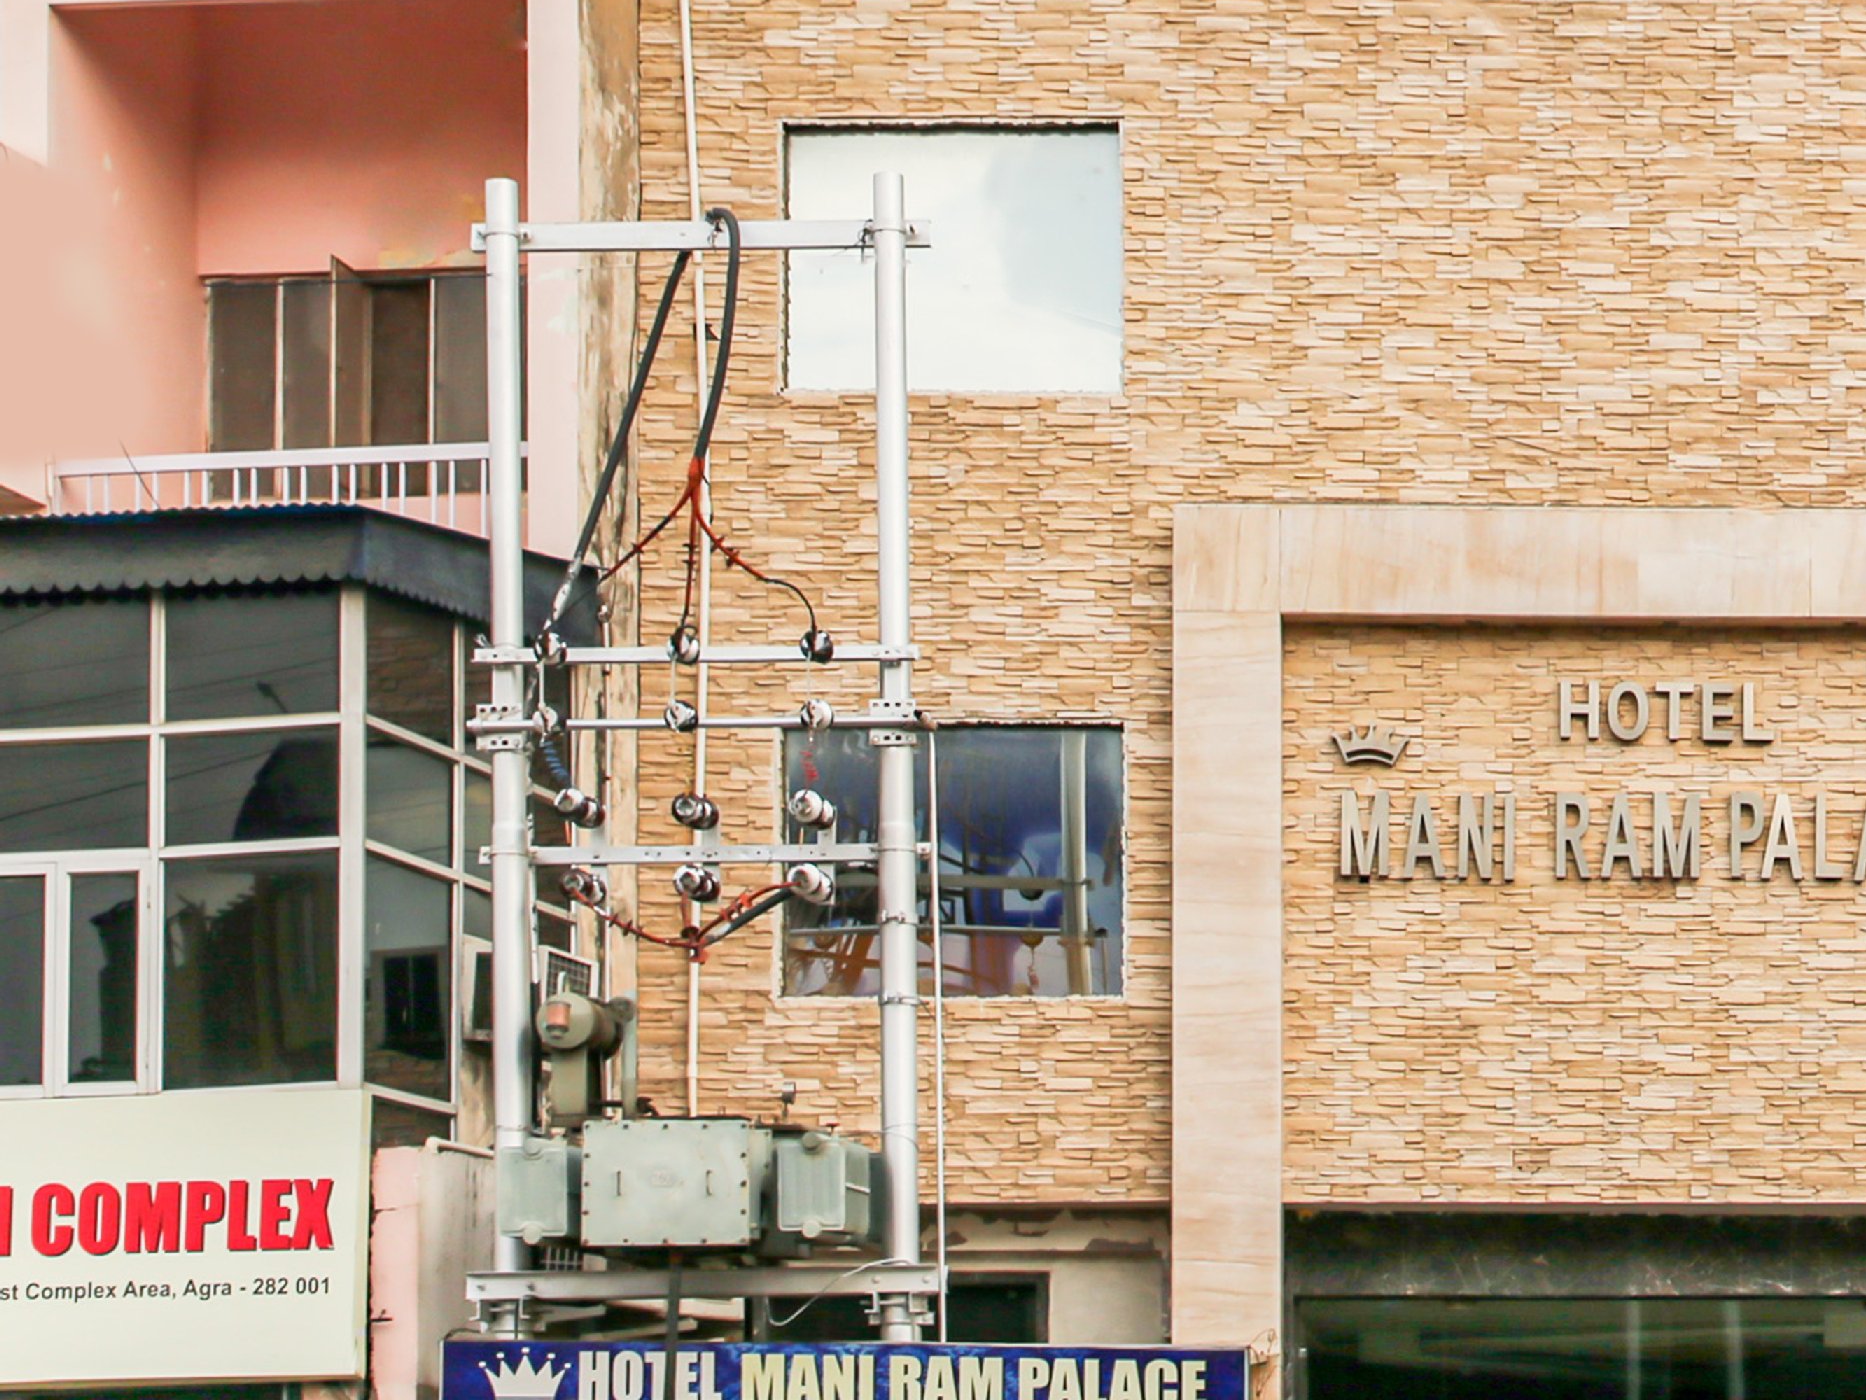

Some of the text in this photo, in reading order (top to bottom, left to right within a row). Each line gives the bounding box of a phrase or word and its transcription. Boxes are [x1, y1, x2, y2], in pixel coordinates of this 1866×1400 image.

[1557, 681, 1776, 743] HOTEL
[1340, 789, 1516, 880] MANI
[1554, 790, 1702, 879] RAM
[31, 1178, 335, 1257] COMPLEX
[25, 1281, 117, 1303] Complex
[122, 1280, 176, 1300] Area,
[182, 1279, 233, 1301] Agra
[252, 1277, 289, 1295] 282
[296, 1277, 331, 1295] 001
[577, 1350, 1207, 1400] HOTEL MANI RAM PALACE
